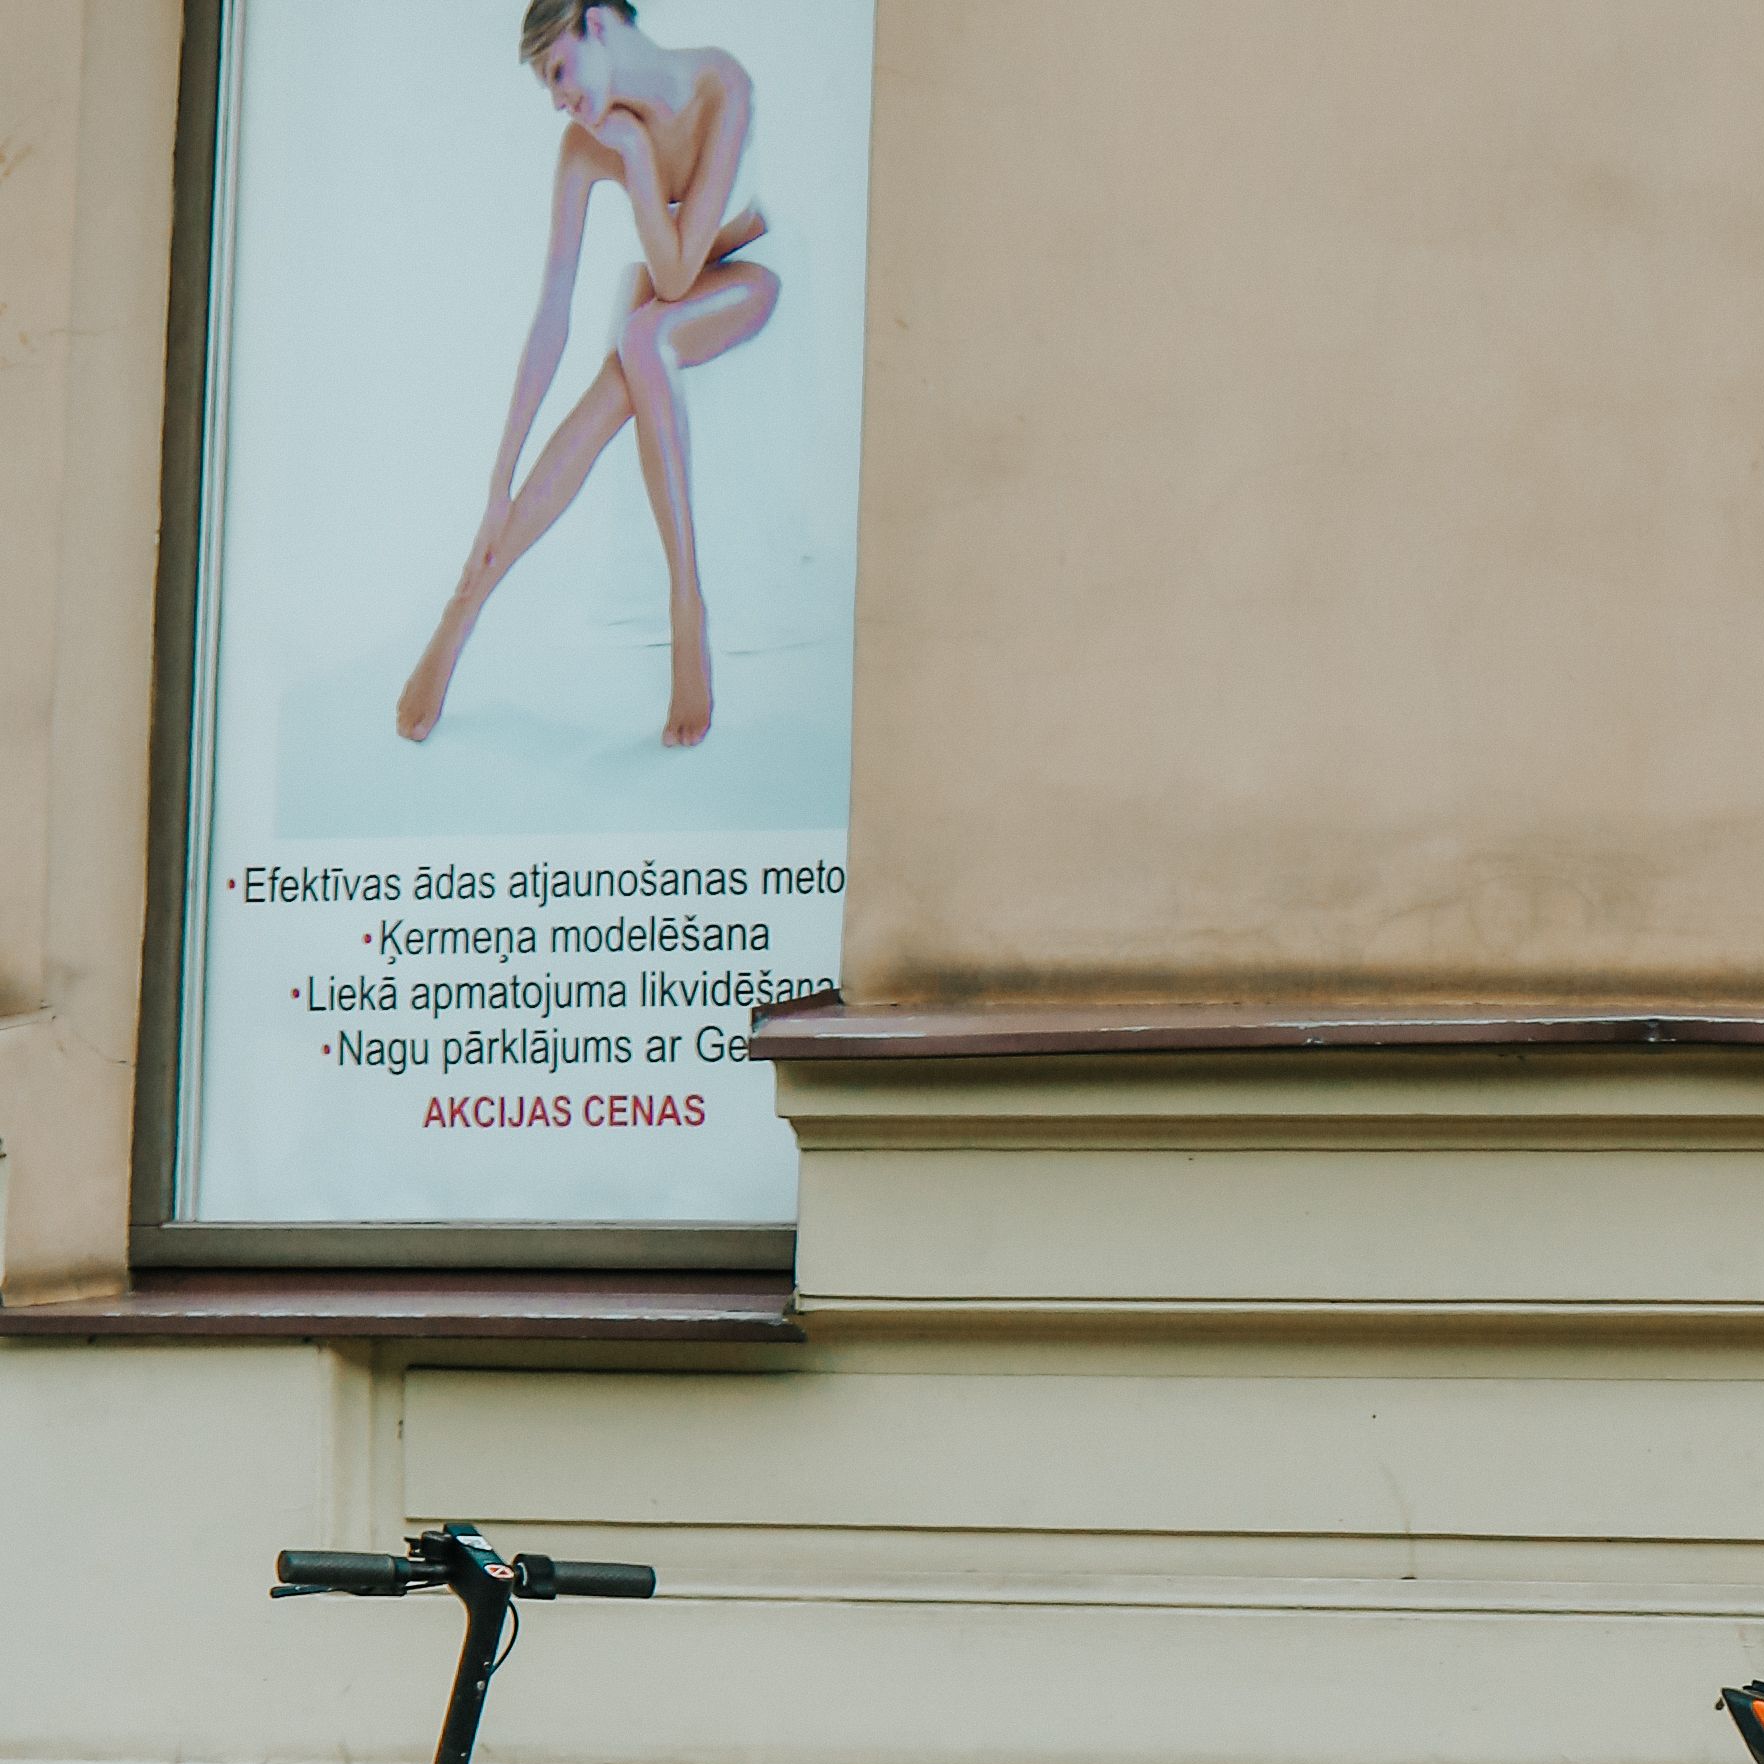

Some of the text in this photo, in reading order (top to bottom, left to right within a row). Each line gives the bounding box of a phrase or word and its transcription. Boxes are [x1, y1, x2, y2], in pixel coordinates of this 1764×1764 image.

[245, 859, 846, 909] Efektīvas ādas atjaunošanas meto
[379, 914, 771, 966] Ķermeņa modelēšana
[307, 973, 398, 1012] Liekā
[410, 971, 628, 1020] apmatojuma
[337, 1024, 749, 1076] Nagu pārklājums ar Ge
[422, 1093, 706, 1129] AKCIJAS CENAS
